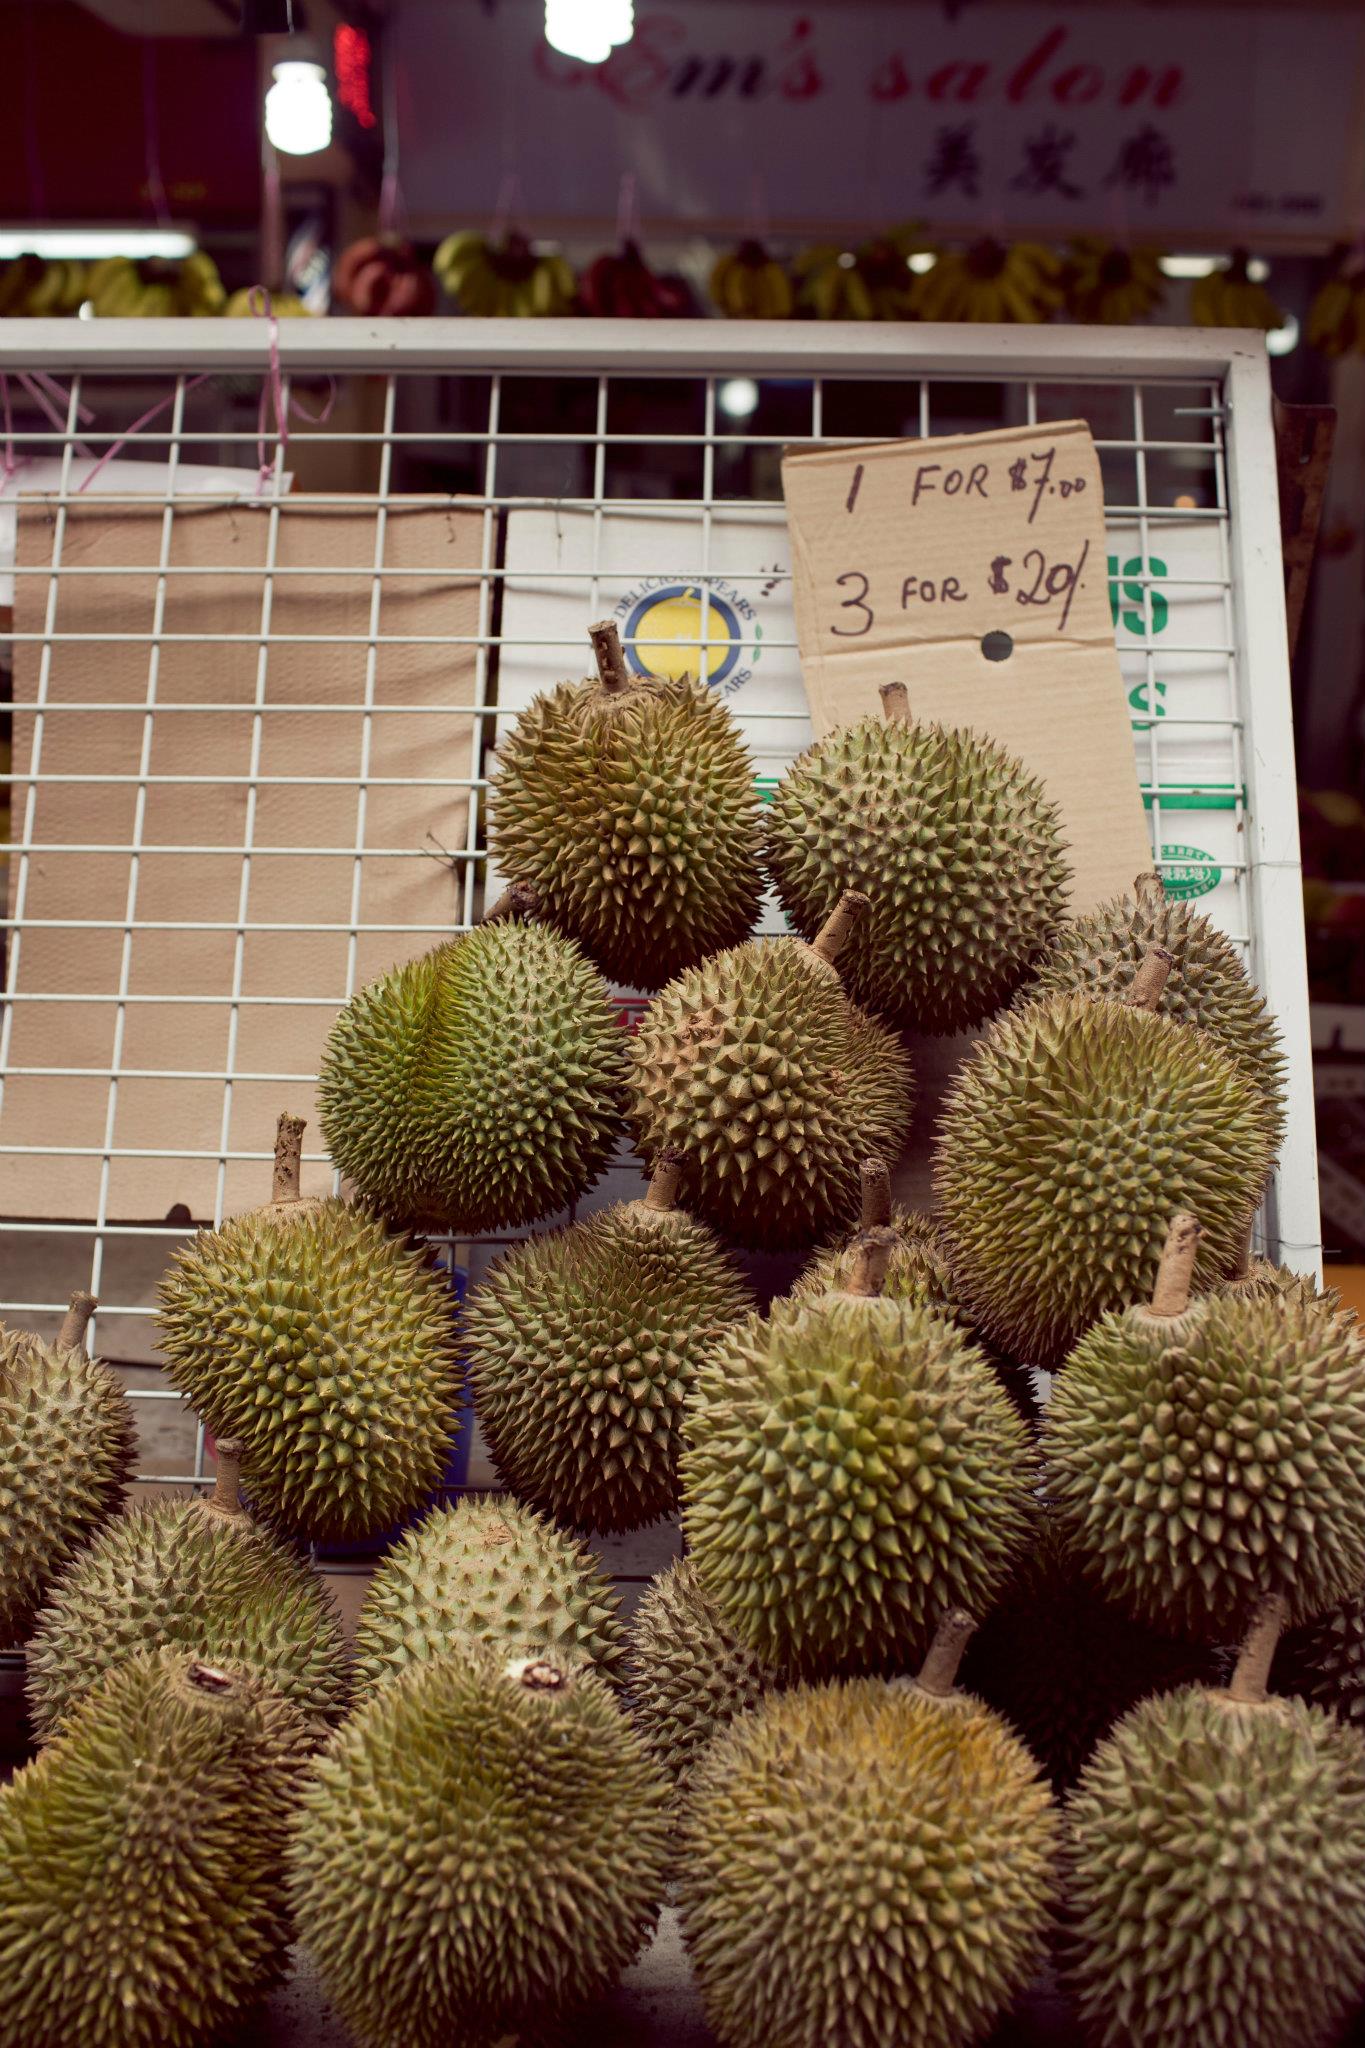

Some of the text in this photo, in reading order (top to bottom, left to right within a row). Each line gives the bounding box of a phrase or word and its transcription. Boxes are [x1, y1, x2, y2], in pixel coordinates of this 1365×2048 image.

[869, 25, 1187, 112] salon
[846, 464, 864, 513] 1
[911, 464, 989, 506] FOR
[706, 576, 757, 621] PEARS
[830, 572, 874, 636] 3
[901, 576, 967, 609] FOR
